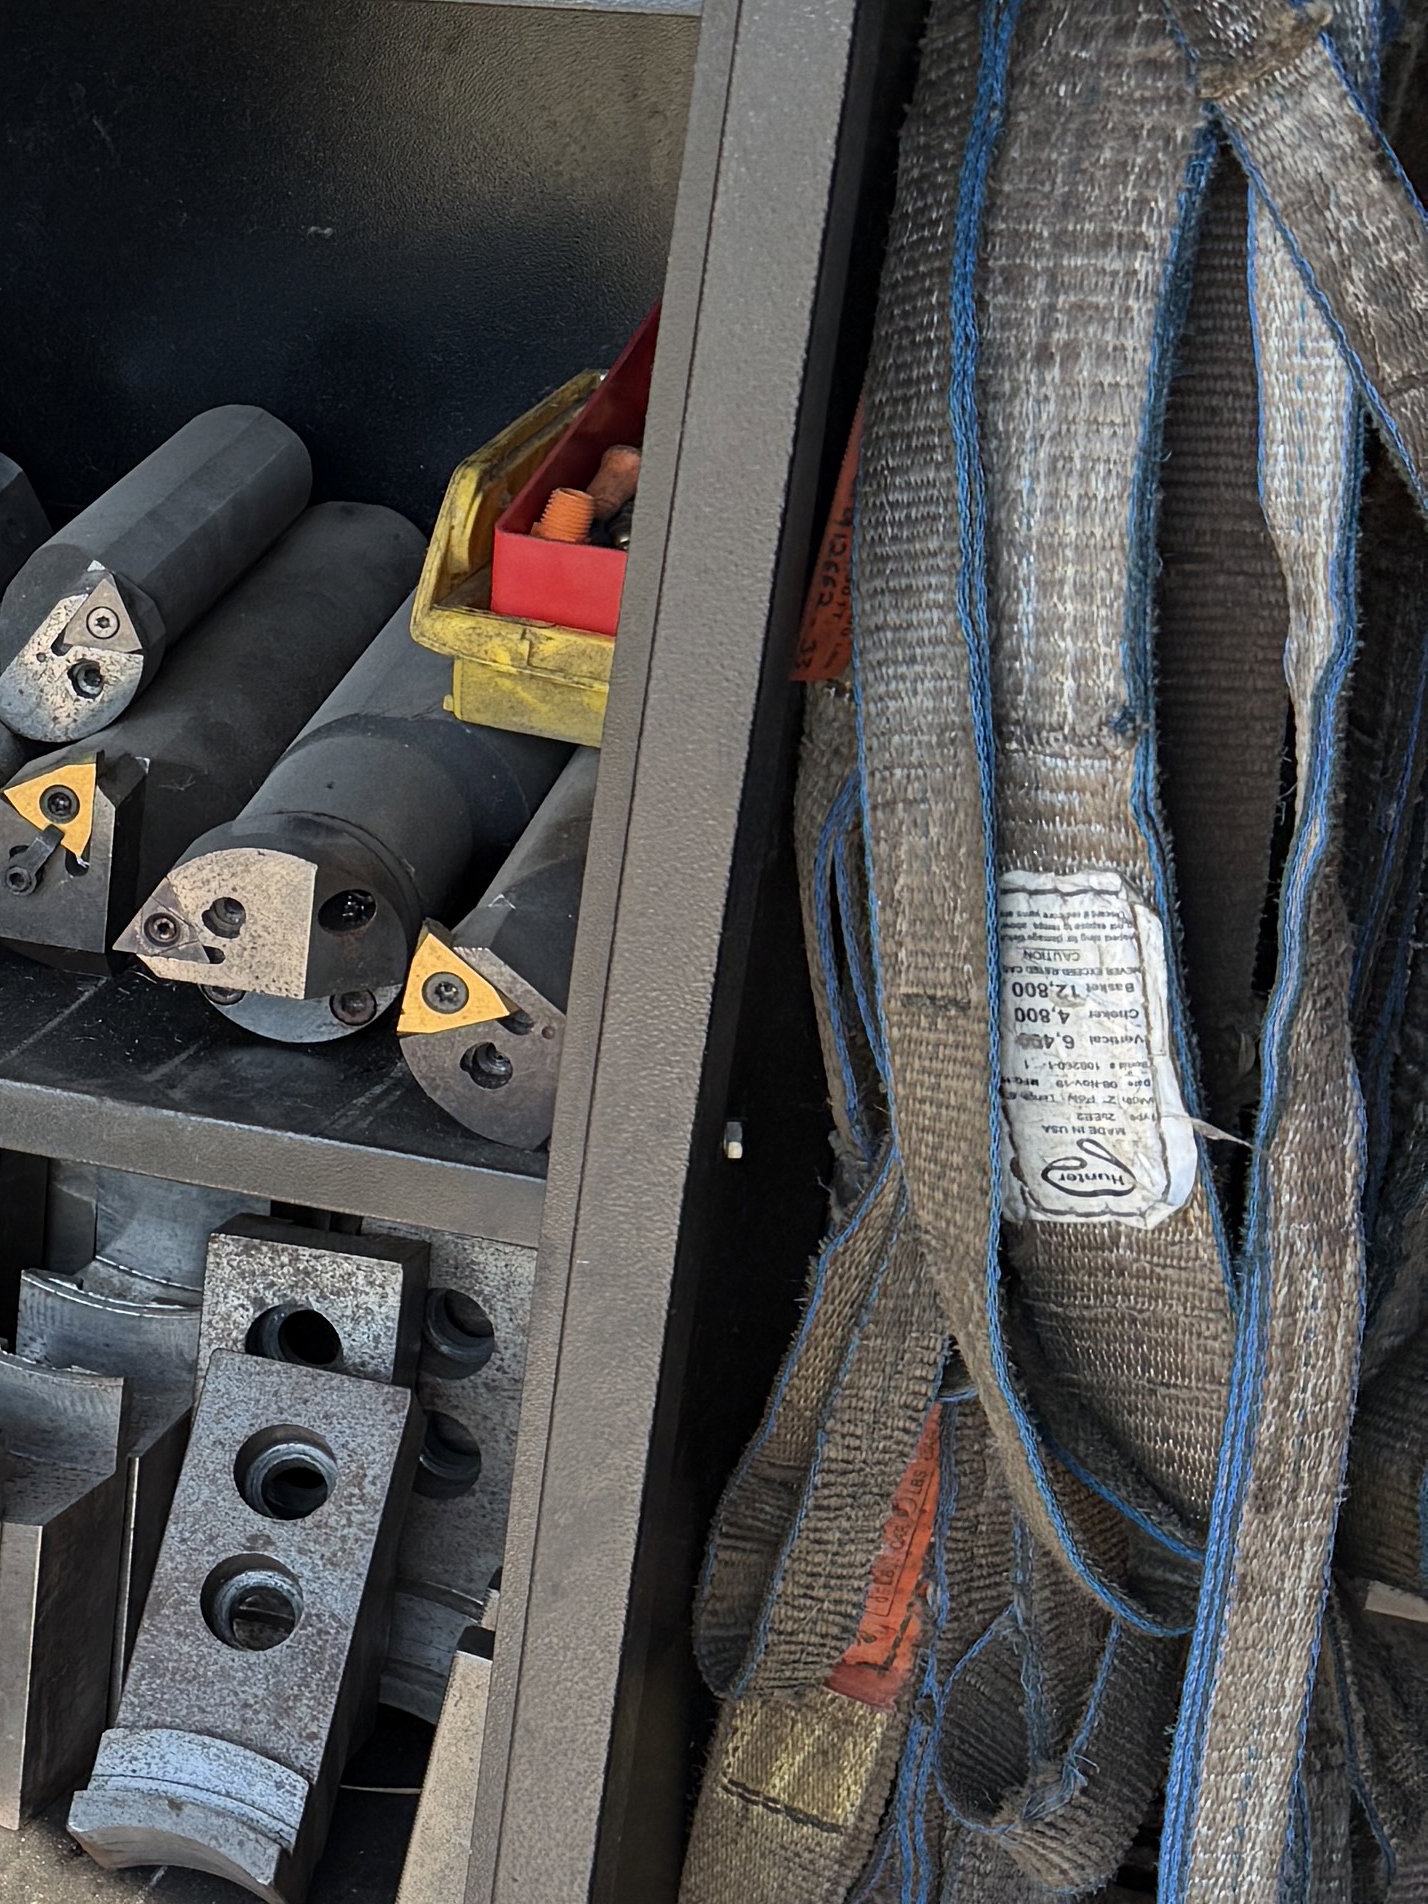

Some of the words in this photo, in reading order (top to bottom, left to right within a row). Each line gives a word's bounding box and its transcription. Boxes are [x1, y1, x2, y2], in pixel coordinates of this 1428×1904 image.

[1023, 950, 1081, 962] CAUTION
[1012, 981, 1080, 998] 12,800
[1086, 982, 1135, 993] Basket
[1014, 1007, 1071, 1025] 4,800
[1089, 1007, 1140, 1020] Choker
[1089, 1034, 1145, 1045] Vertical
[1042, 1124, 1069, 1134] USA
[1072, 1126, 1086, 1135] IN
[1088, 1125, 1126, 1135] MADE
[1058, 1171, 1125, 1187] Hunter
